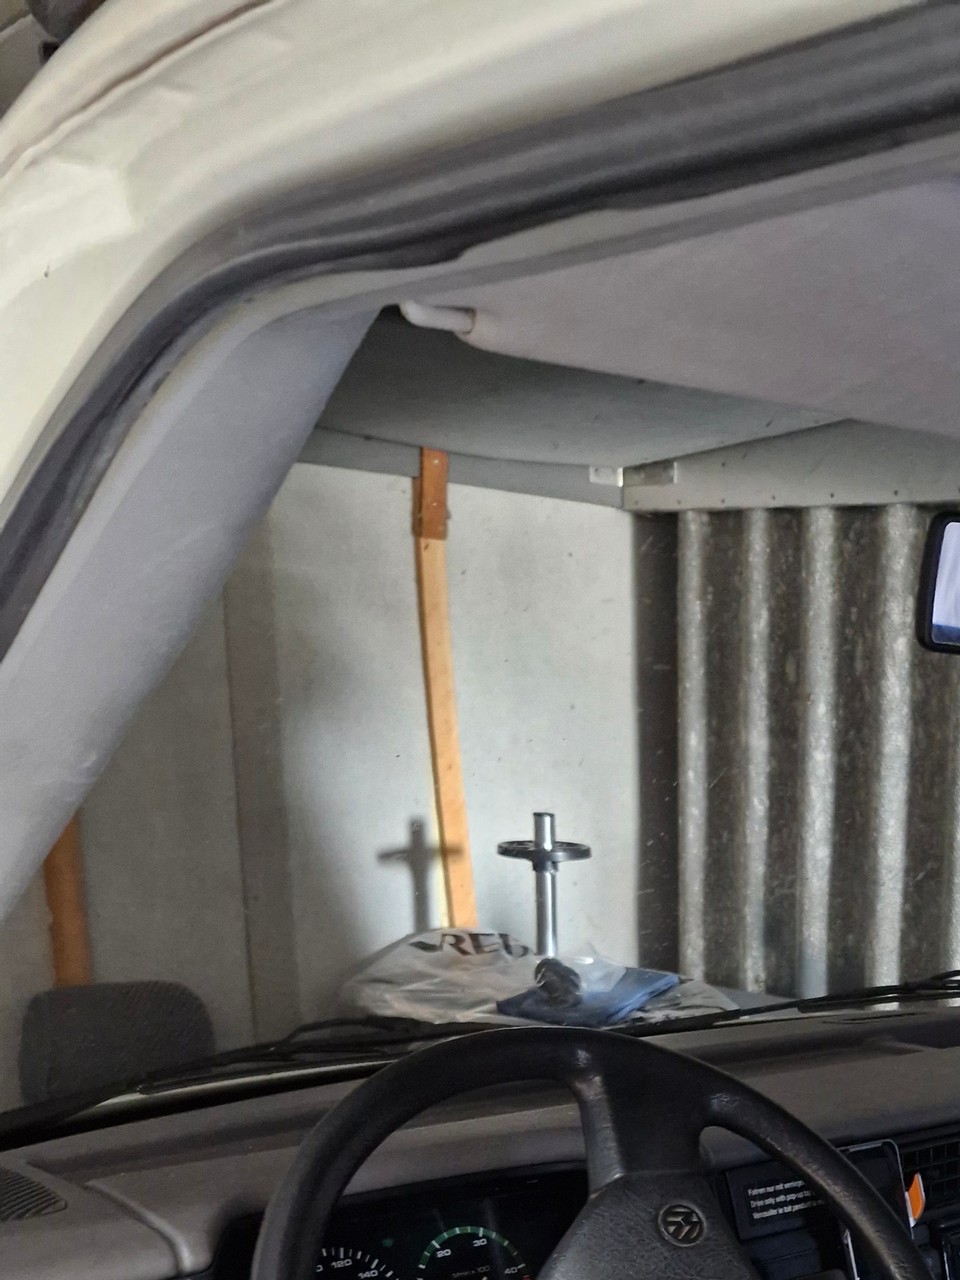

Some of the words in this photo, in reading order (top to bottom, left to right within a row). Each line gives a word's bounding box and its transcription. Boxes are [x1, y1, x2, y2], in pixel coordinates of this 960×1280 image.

[472, 1237, 488, 1247] 30
[436, 1248, 452, 1258] 20
[330, 1258, 353, 1269] 120
[358, 1269, 379, 1280] 140
[504, 1267, 518, 1275] 40
